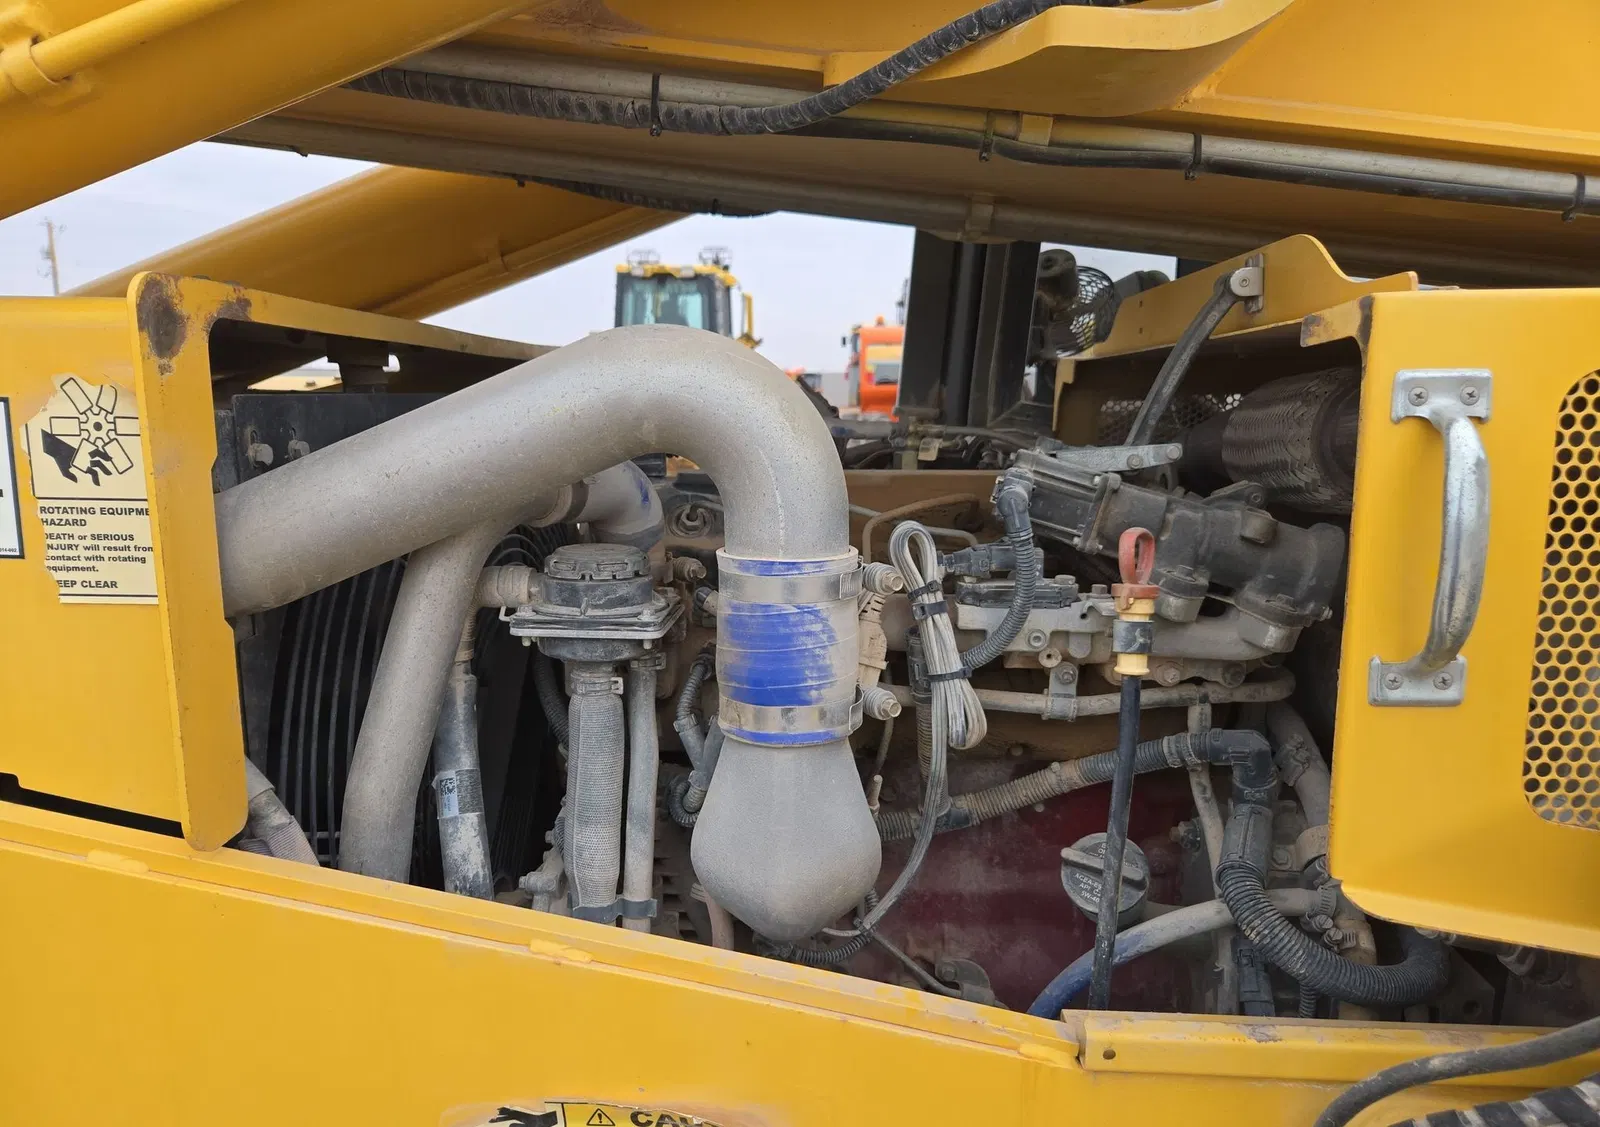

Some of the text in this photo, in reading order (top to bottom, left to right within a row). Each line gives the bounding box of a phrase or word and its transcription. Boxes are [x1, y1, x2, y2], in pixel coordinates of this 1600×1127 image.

[39, 506, 150, 516] ROTATING EQUIPME
[41, 518, 87, 527] HAZARD
[90, 533, 135, 541] SERIOUS
[47, 543, 79, 551] NJURY
[83, 543, 100, 551] will
[102, 544, 131, 552] result
[83, 554, 105, 562] with
[108, 555, 147, 564] rotating
[46, 564, 99, 573] equipment.
[56, 580, 118, 589] EEP CLEAR
